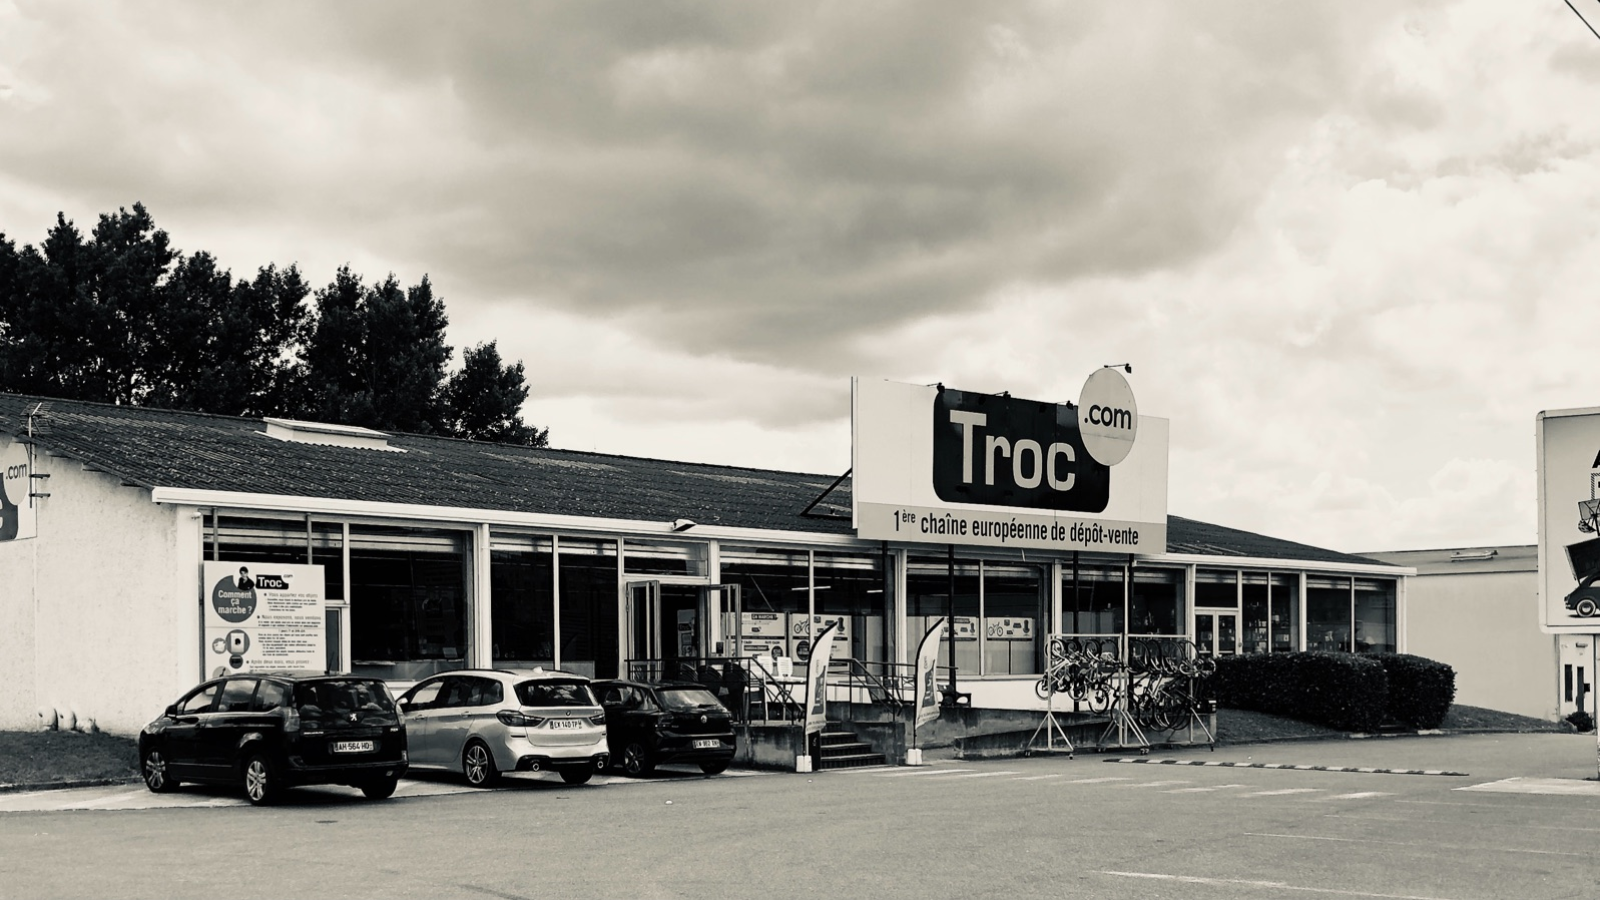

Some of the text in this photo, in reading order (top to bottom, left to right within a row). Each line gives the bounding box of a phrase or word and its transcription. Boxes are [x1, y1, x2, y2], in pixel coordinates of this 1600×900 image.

[1084, 404, 1132, 430] .com
[949, 409, 1076, 491] Troc
[5, 463, 28, 480] .com
[893, 509, 1139, 546] 1ère chaîne européenne de dépôt-vente
[257, 576, 283, 588] Troc
[217, 590, 252, 599] Comment
[230, 598, 240, 607] ça
[217, 606, 253, 614] marche ?
